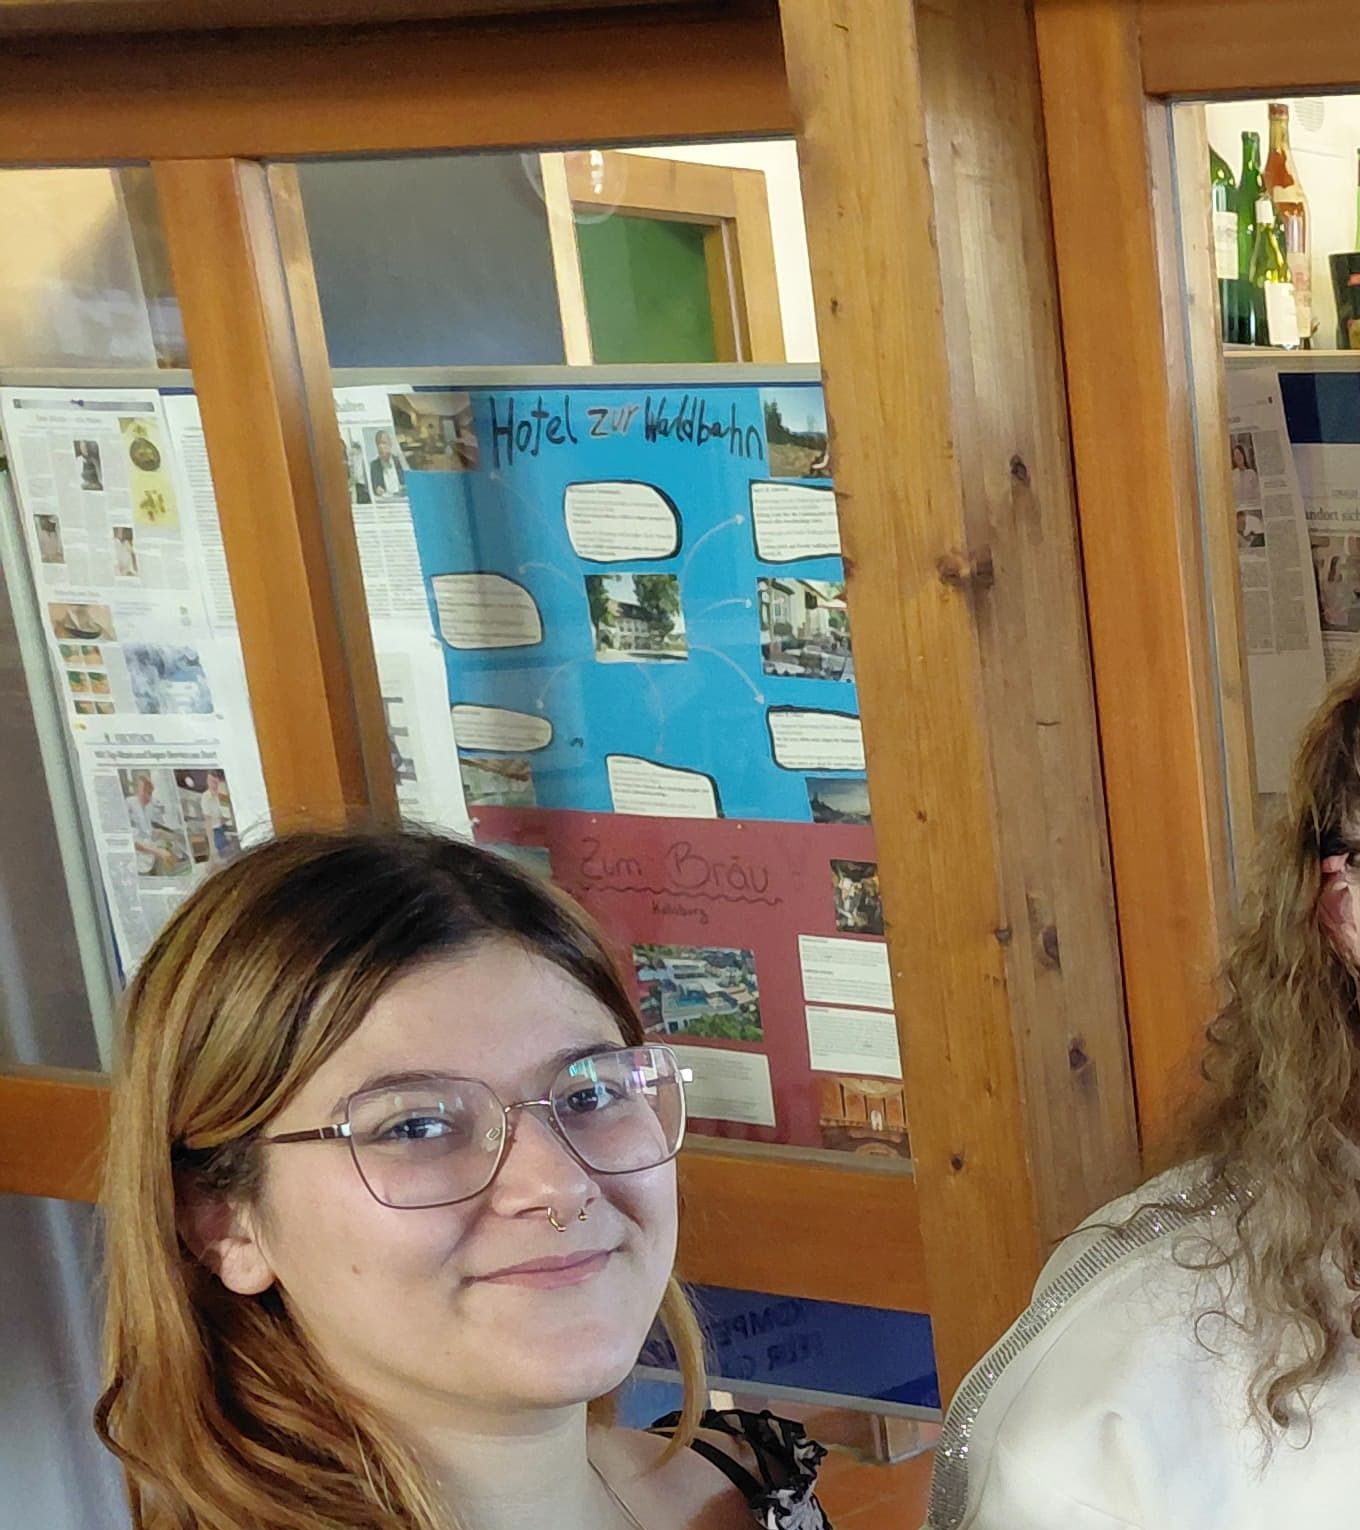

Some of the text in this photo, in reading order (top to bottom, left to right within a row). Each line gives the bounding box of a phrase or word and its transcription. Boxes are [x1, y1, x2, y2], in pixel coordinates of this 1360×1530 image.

[488, 394, 577, 469] Hotel
[587, 404, 640, 438] zur
[580, 836, 643, 880] Zum
